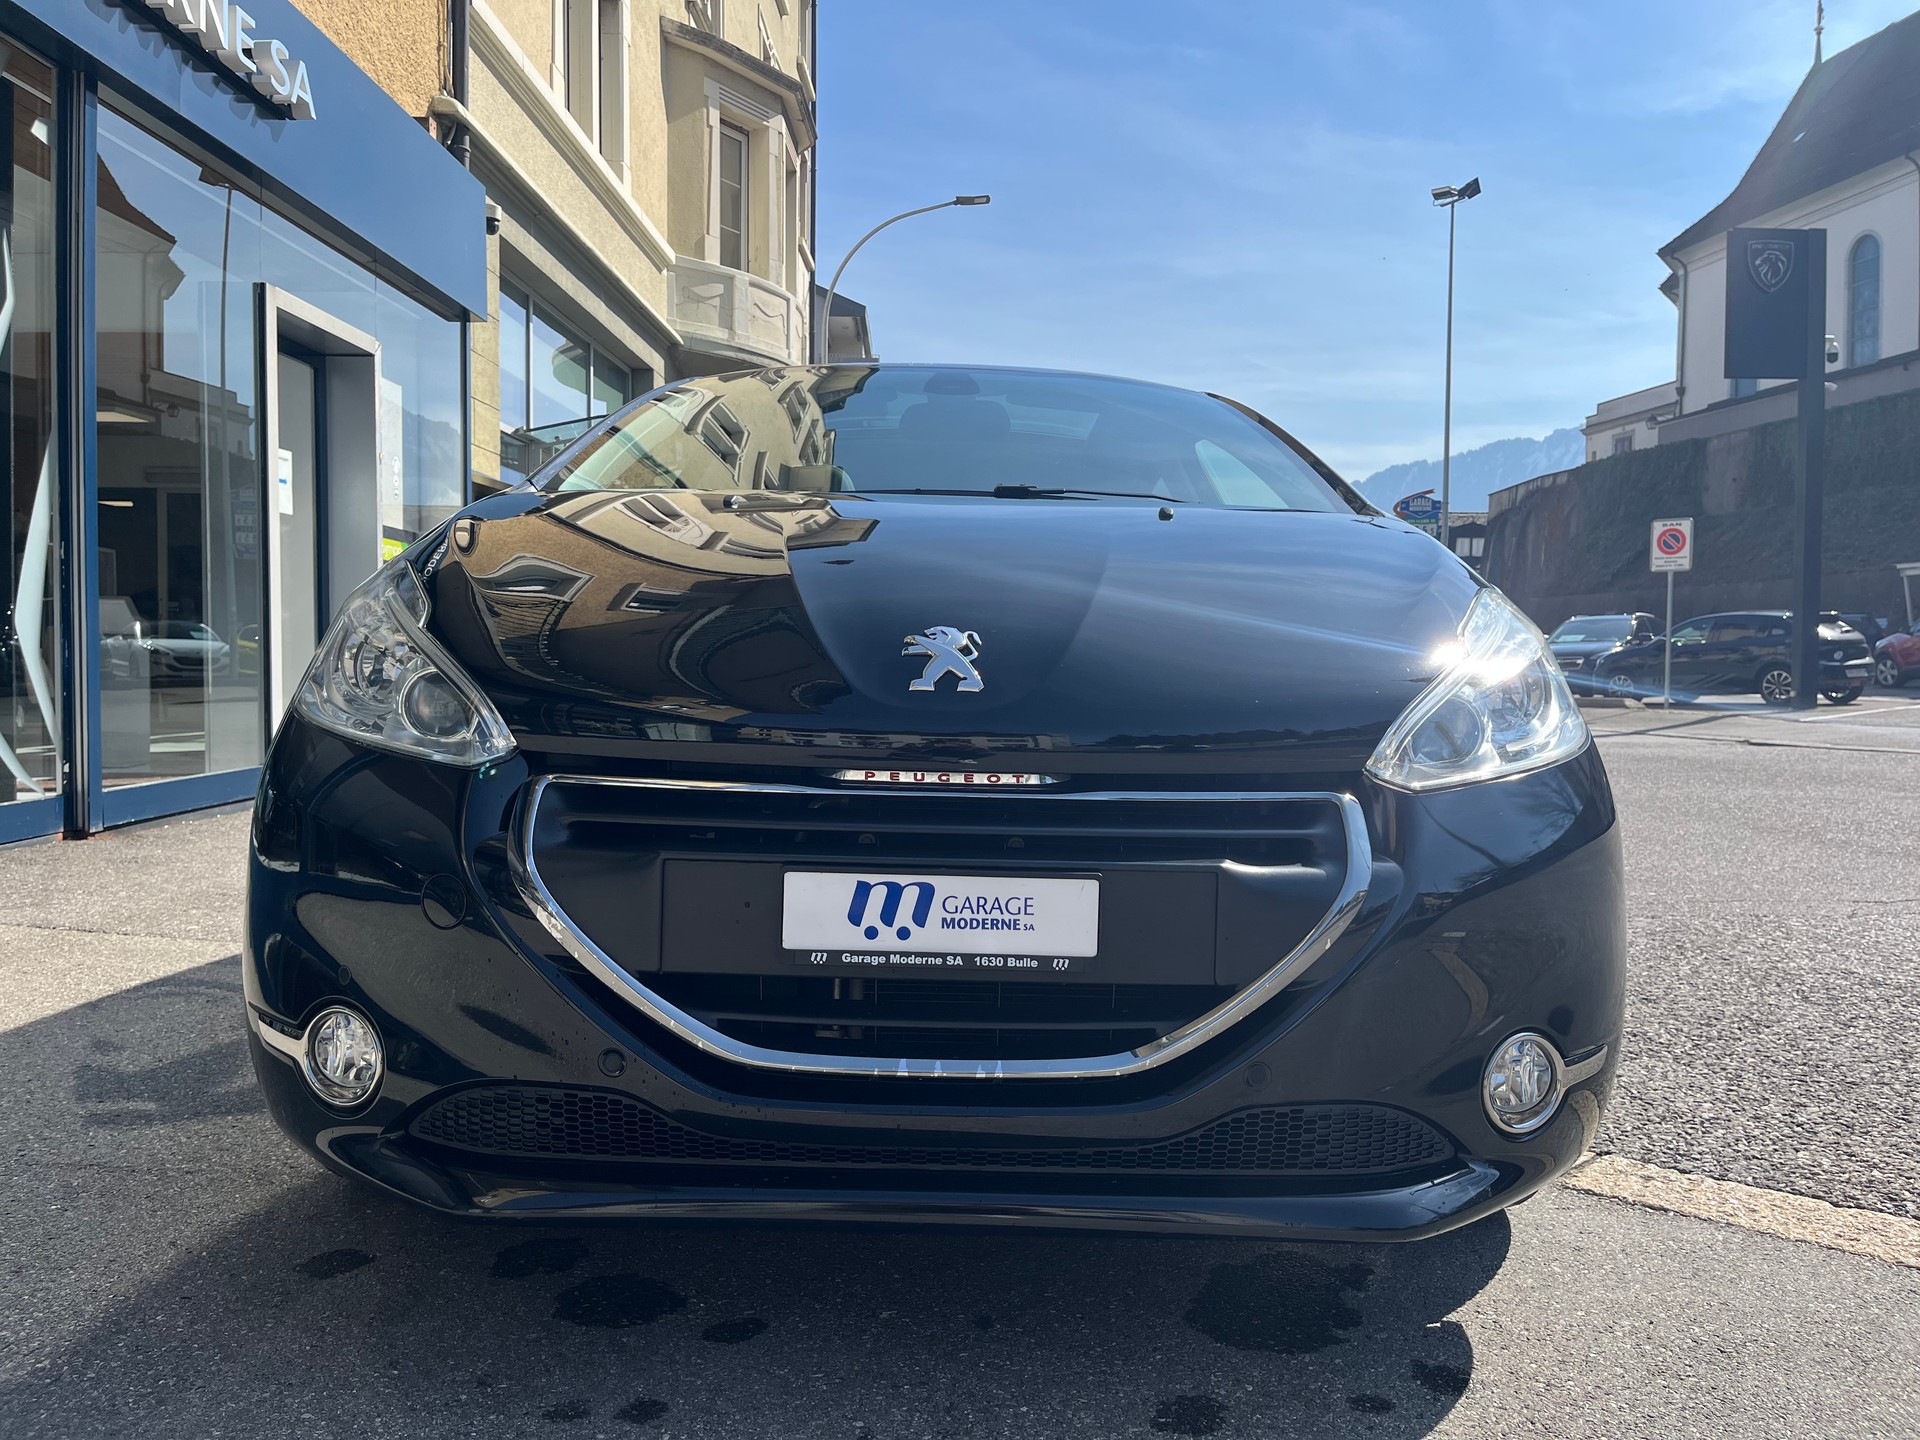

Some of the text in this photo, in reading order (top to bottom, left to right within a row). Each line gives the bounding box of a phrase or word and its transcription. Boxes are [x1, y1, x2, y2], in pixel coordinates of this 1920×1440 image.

[252, 39, 317, 121] SA
[864, 771, 1025, 784] PEUGEOT
[941, 895, 1035, 916] GARAGE
[941, 917, 1035, 932] MODERNE SA
[841, 952, 887, 967] Garage
[889, 953, 943, 966] Moderne
[946, 955, 964, 966] SA
[973, 956, 1004, 967] 1630
[1006, 956, 1039, 968] Bulle
